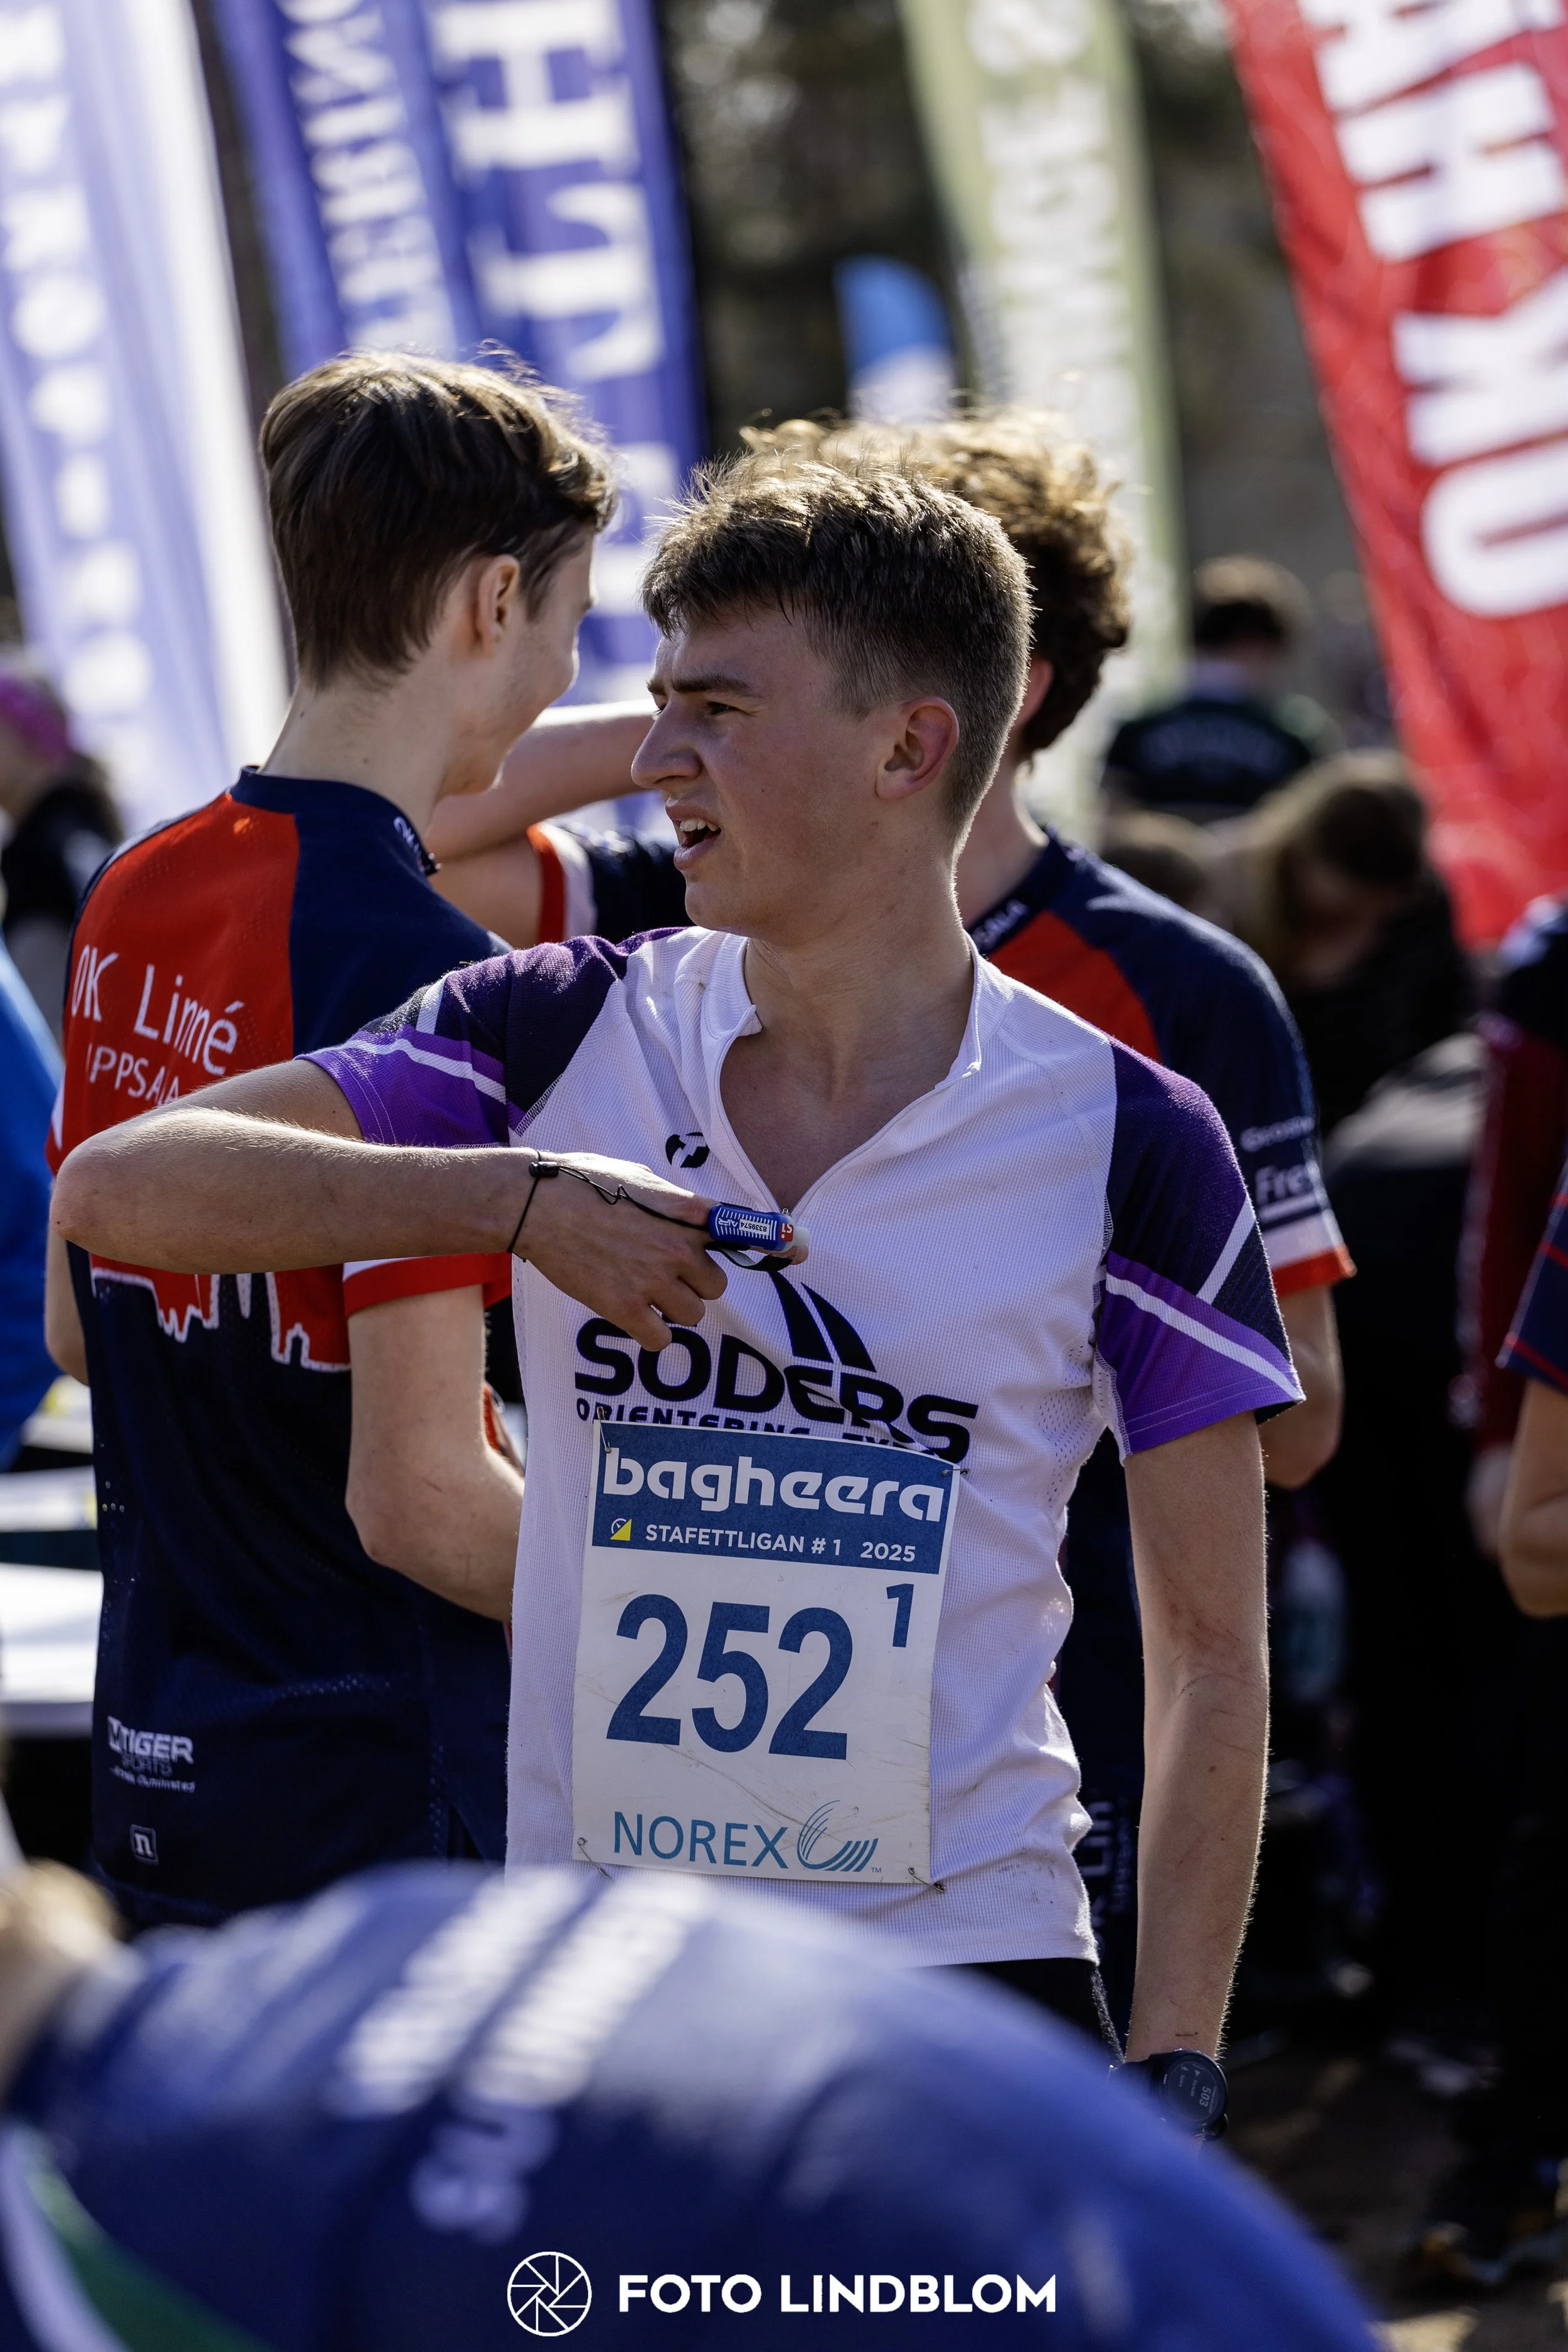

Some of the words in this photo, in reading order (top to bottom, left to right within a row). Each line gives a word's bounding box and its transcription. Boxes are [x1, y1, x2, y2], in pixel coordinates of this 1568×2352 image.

[72, 943, 120, 1022] OK
[133, 963, 245, 1076] Linné
[85, 1042, 179, 1107] PPSALA
[741, 1221, 767, 1232] 8339574
[603, 1448, 944, 1522] bagheera
[645, 1524, 804, 1553] STAFETTLIGAN
[860, 1542, 916, 1562] 2025
[886, 1584, 914, 1648] 1
[607, 1594, 853, 1761] 252
[613, 1811, 789, 1870] NOREX
[1199, 2085, 1212, 2107] 503
